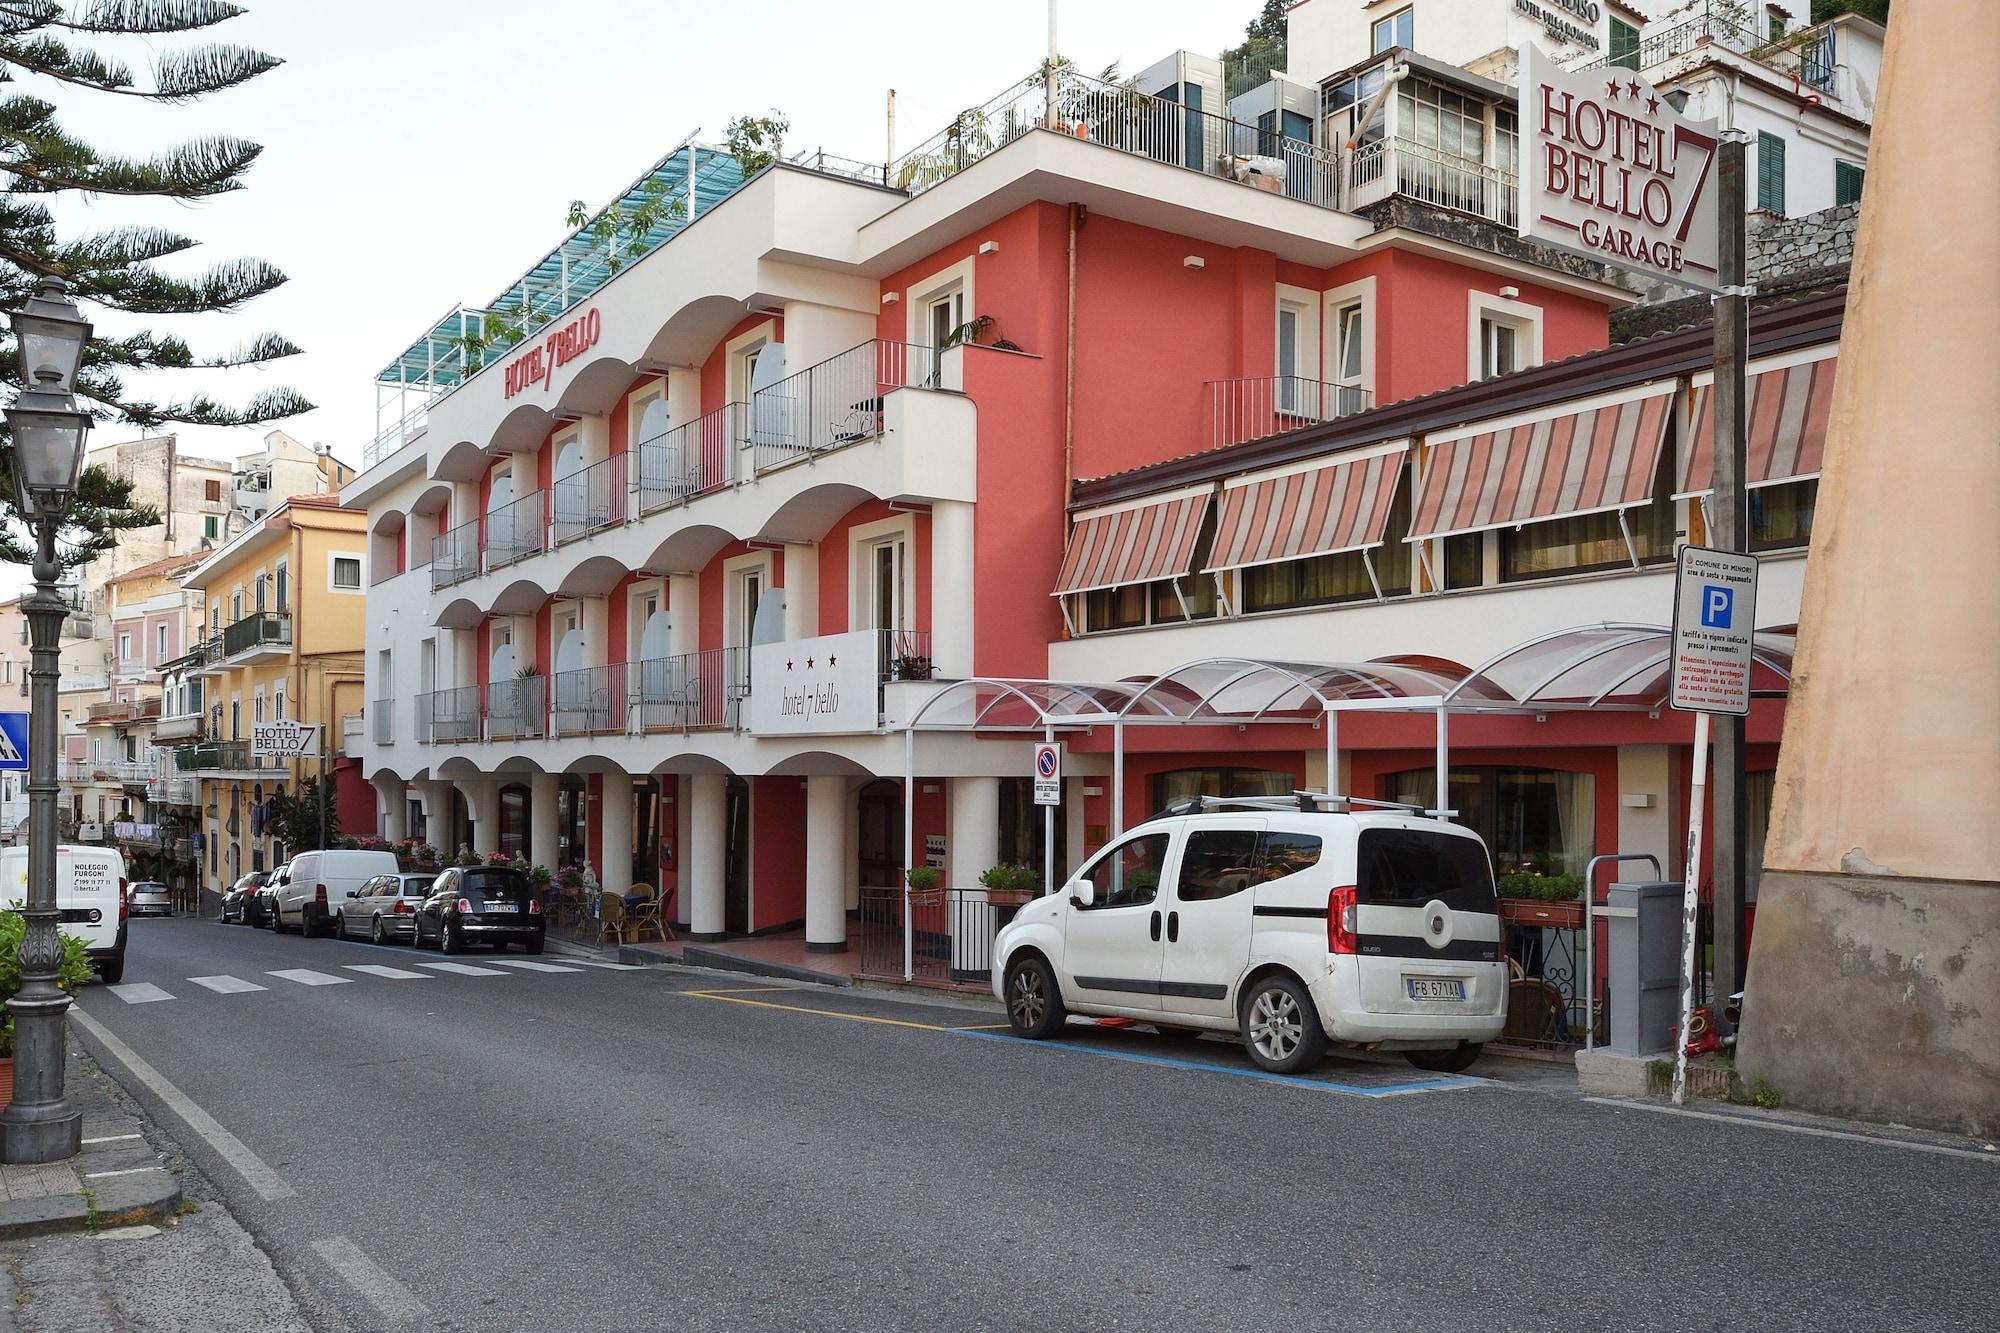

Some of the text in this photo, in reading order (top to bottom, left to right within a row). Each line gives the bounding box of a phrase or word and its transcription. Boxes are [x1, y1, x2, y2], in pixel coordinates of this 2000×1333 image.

[1542, 10, 1564, 32] VILLA
[1565, 22, 1599, 50] ROMANA
[1539, 83, 1675, 180] HOTEL
[1544, 141, 1672, 228] BELLO
[1673, 122, 1718, 243] 7
[1579, 219, 1683, 273] GARAGE
[504, 307, 600, 399] HOTEL 7 BELLO
[1695, 560, 1720, 570] COMUNE
[1731, 565, 1752, 574] MINORI
[1700, 569, 1705, 577] di
[1706, 571, 1719, 579] sosta
[1726, 575, 1752, 584] pagamento
[1708, 590, 1728, 623] P
[1682, 630, 1748, 645] tariffe in vigore indicate
[1687, 642, 1704, 650] presso
[1710, 646, 1739, 654] parcometri
[1681, 665, 1712, 675] contrassegno
[1720, 669, 1744, 679] parcheggio
[1690, 675, 1708, 683] disabili
[1679, 682, 1688, 690] alla
[1690, 684, 1703, 692] sosta
[781, 682, 839, 722] hotel 7 bello
[254, 727, 300, 739] HOTEL
[300, 727, 316, 751] 7
[256, 738, 299, 750] BELLO
[267, 750, 303, 758] GARAGE
[1415, 982, 1460, 997] FB 671AA
